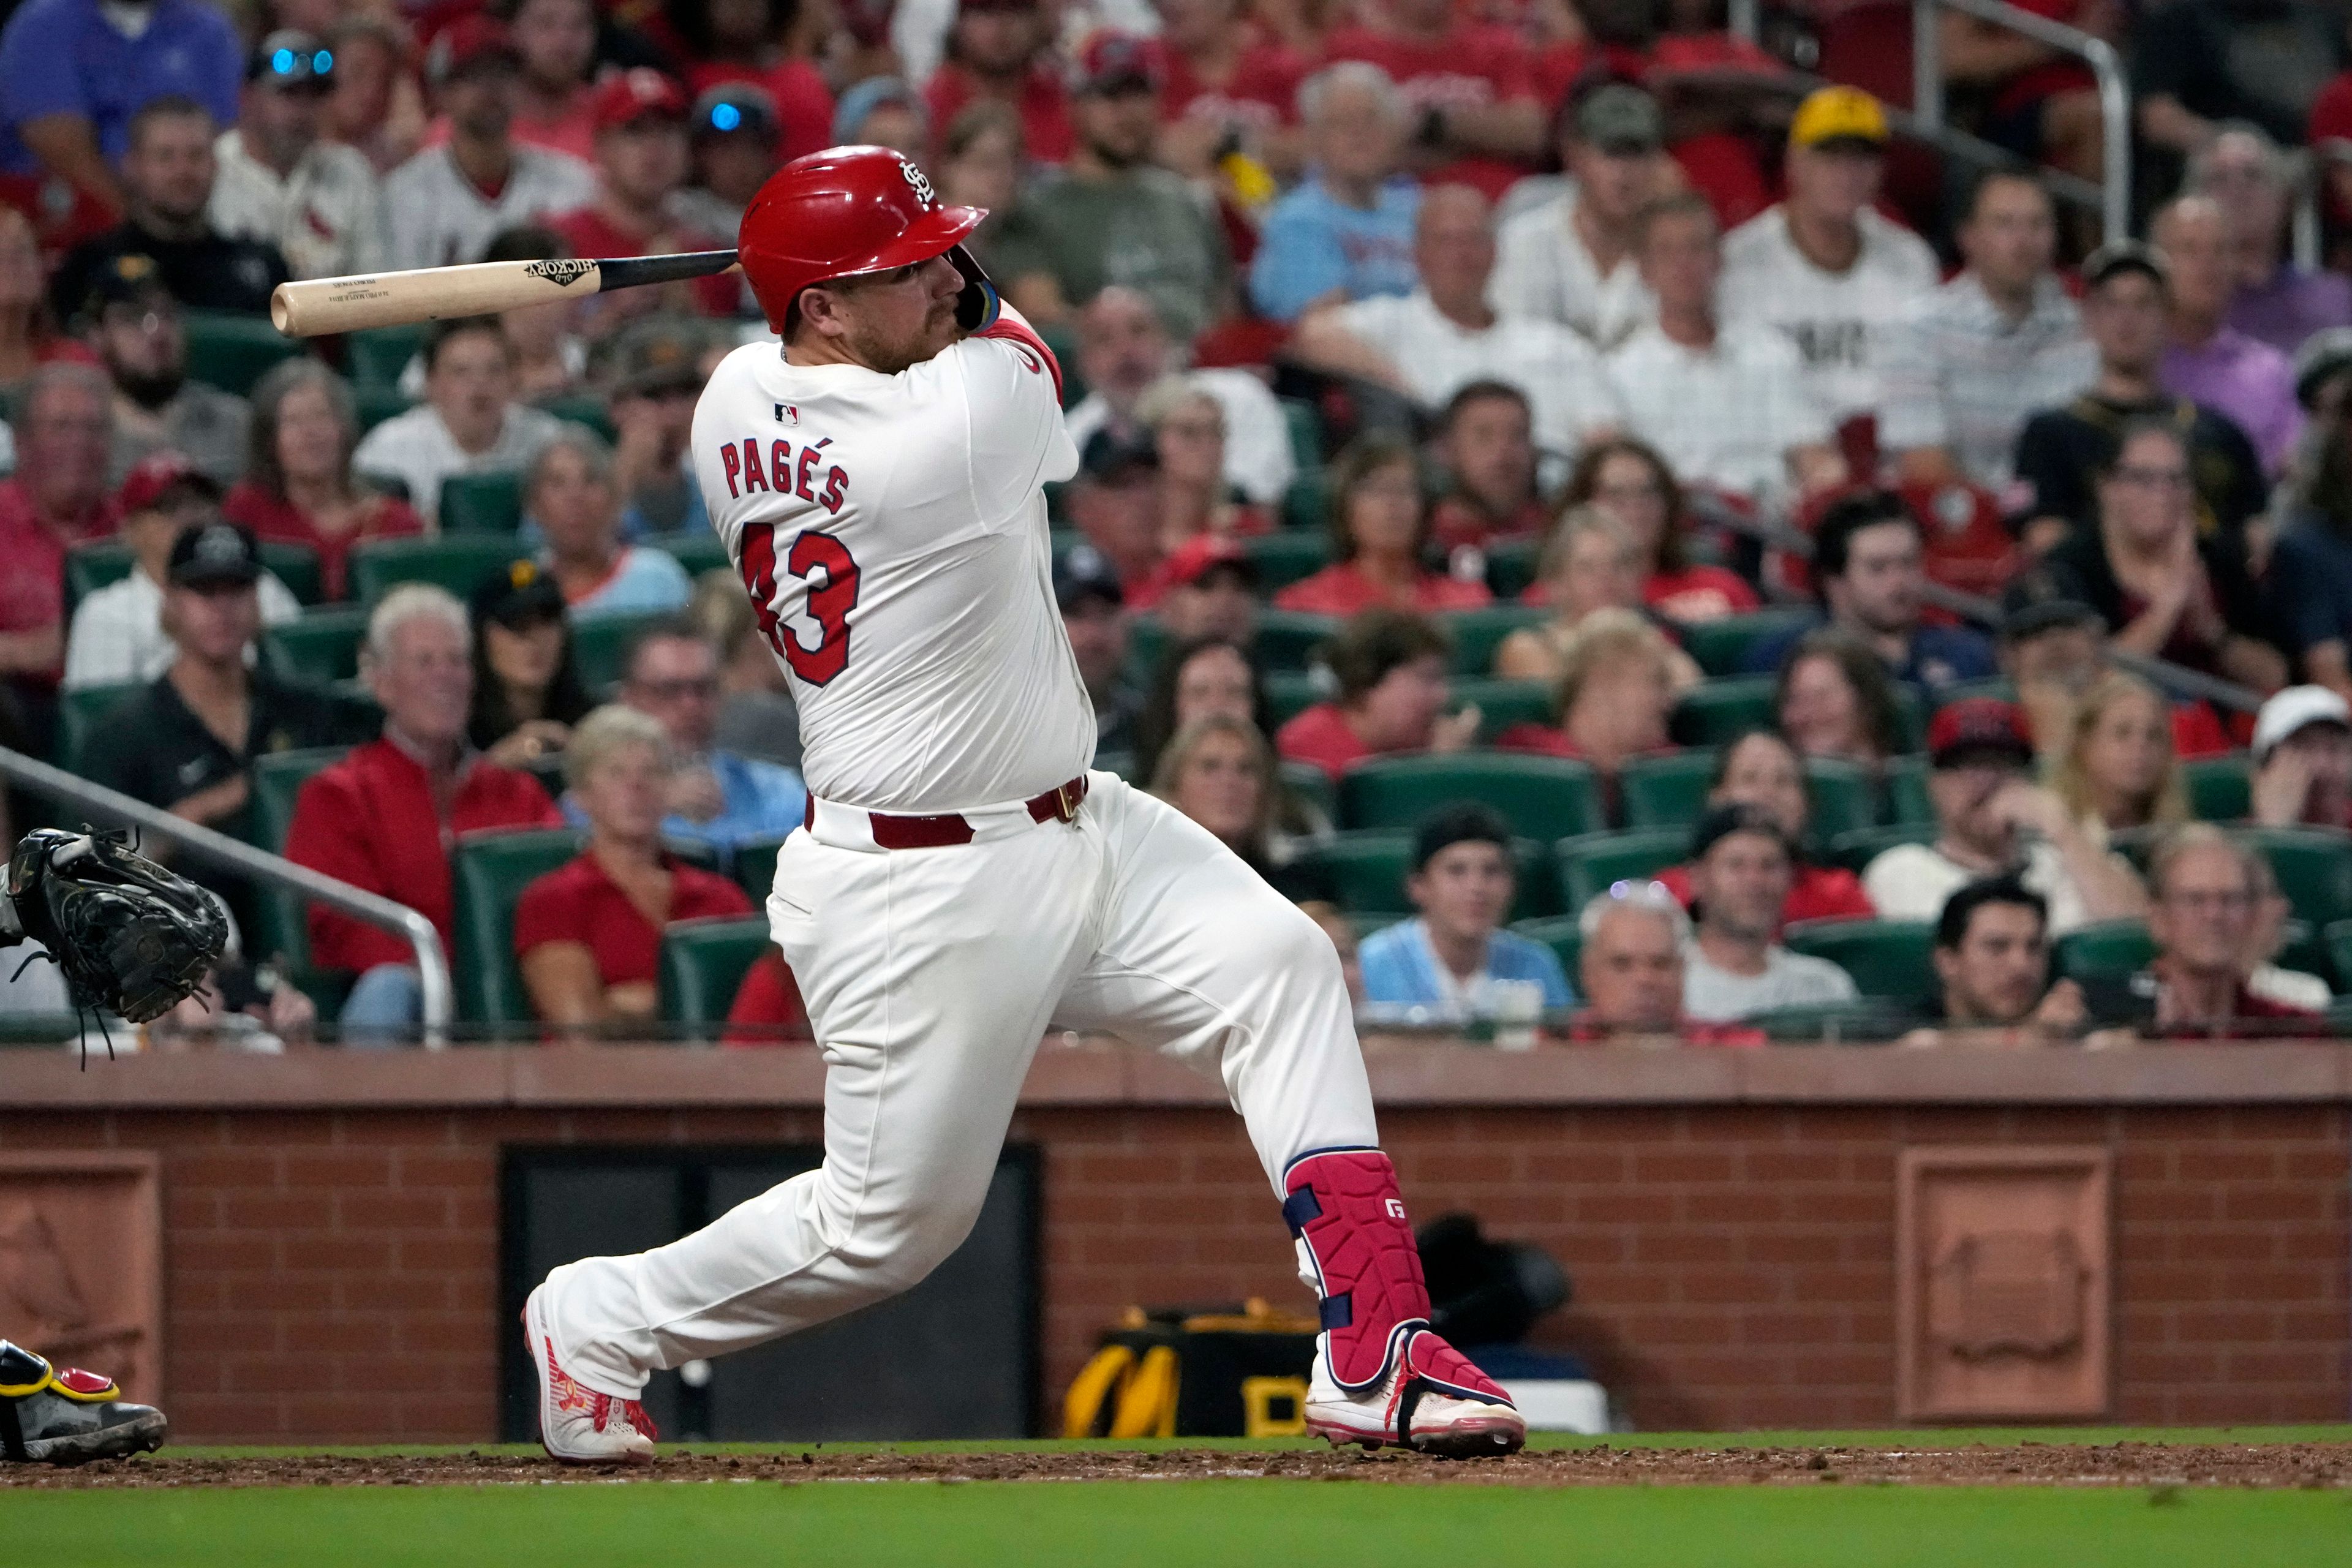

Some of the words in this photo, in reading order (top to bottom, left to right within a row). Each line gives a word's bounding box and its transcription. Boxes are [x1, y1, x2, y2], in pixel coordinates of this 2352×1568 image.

[527, 259, 595, 276] HICKORY
[555, 274, 573, 283] OLD
[720, 437, 850, 515] PAGÉS
[740, 521, 861, 688] 43
